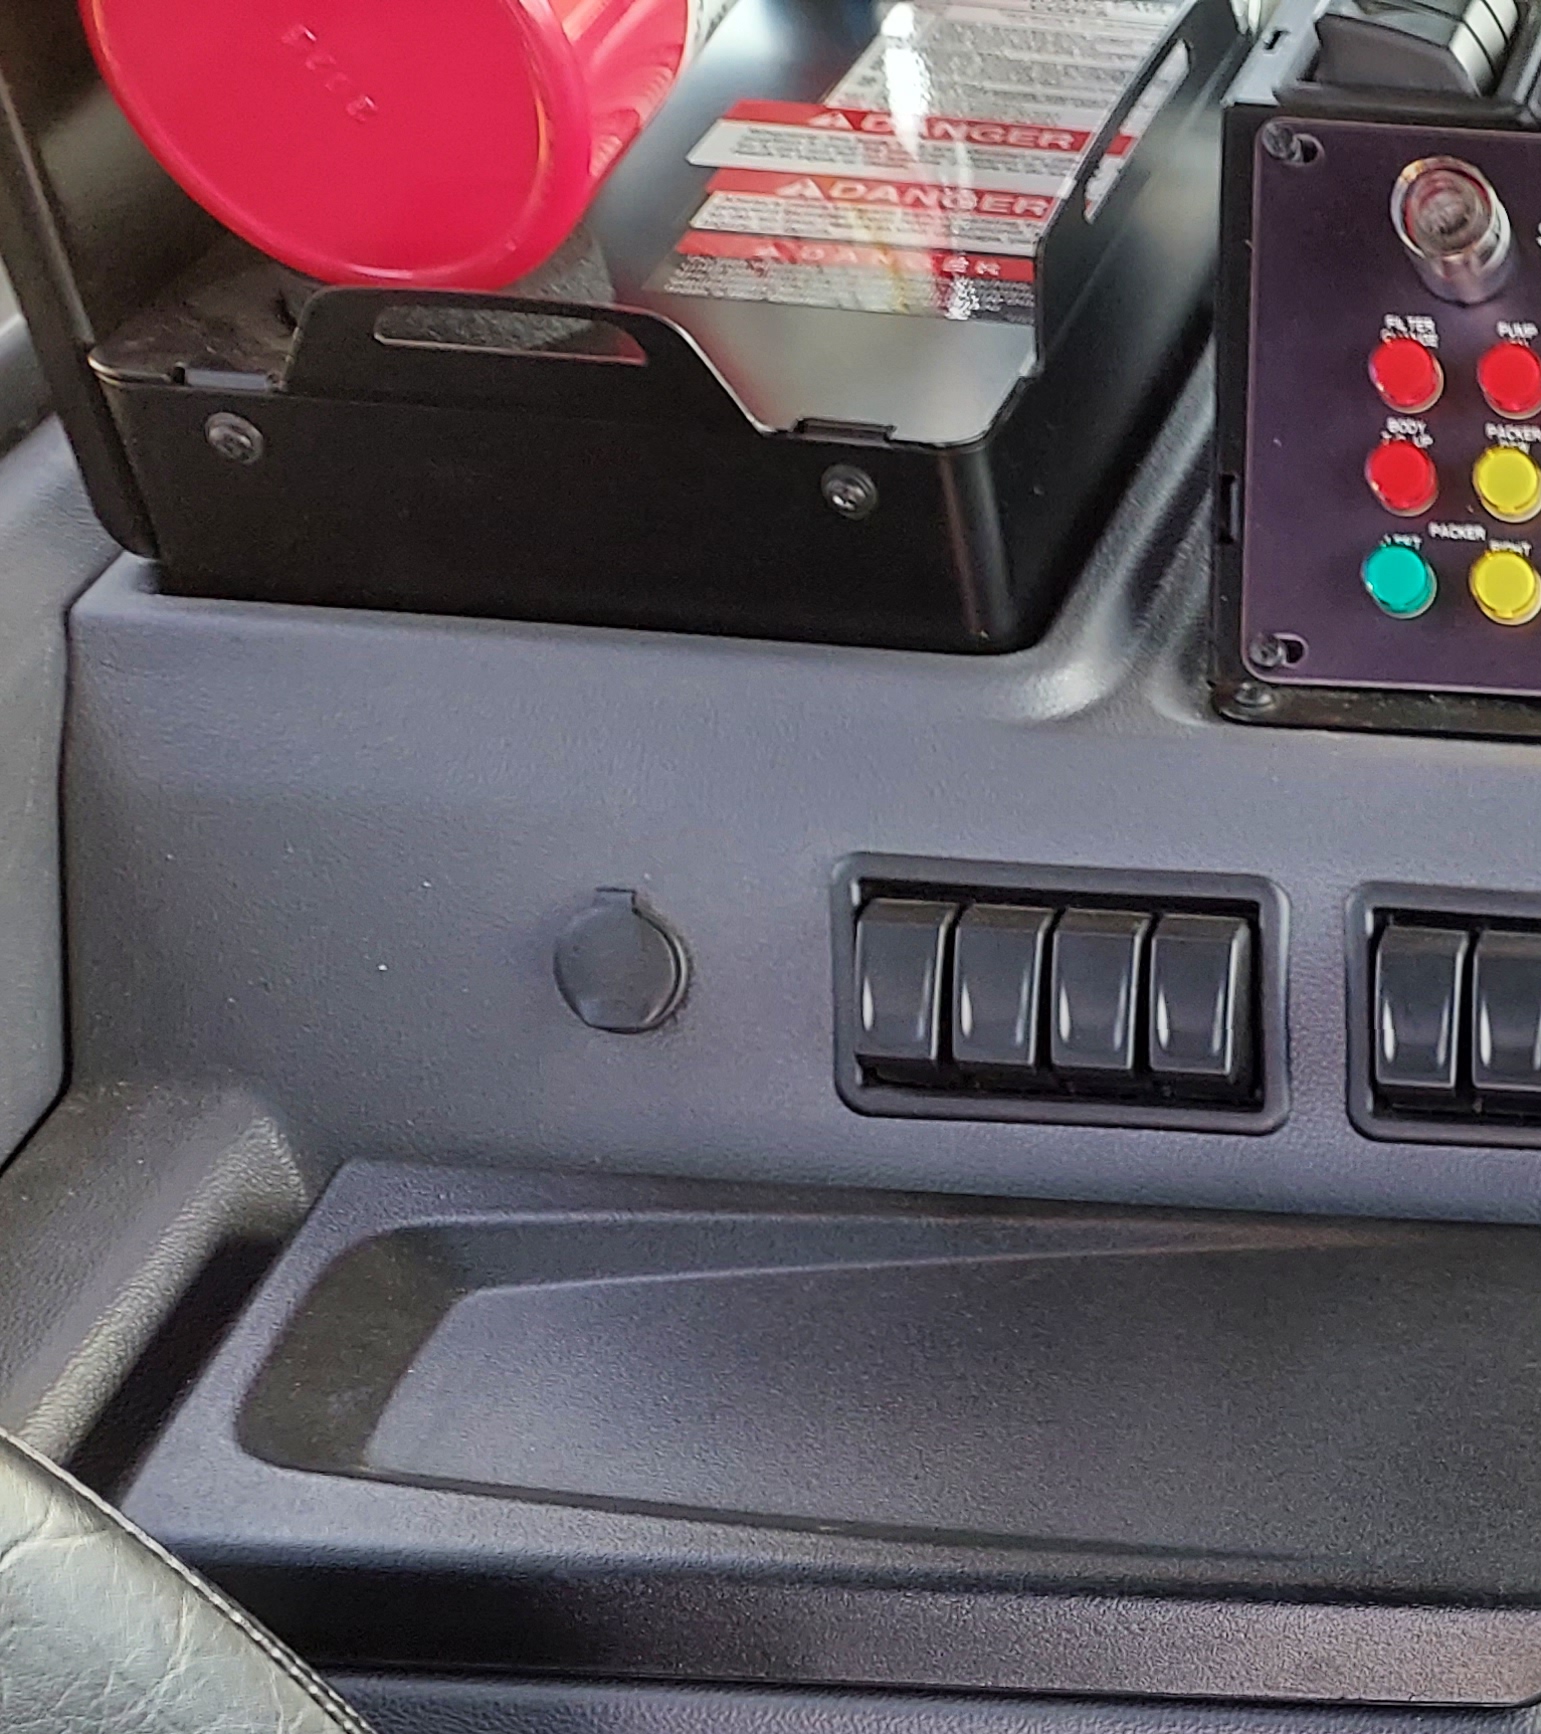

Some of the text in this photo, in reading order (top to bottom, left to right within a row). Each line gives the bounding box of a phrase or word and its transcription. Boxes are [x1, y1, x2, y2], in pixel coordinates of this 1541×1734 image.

[860, 113, 1075, 150] DNGER
[1387, 417, 1426, 434] BODY
[1428, 521, 1487, 541] PACKER
[1379, 533, 1422, 550] EFT
